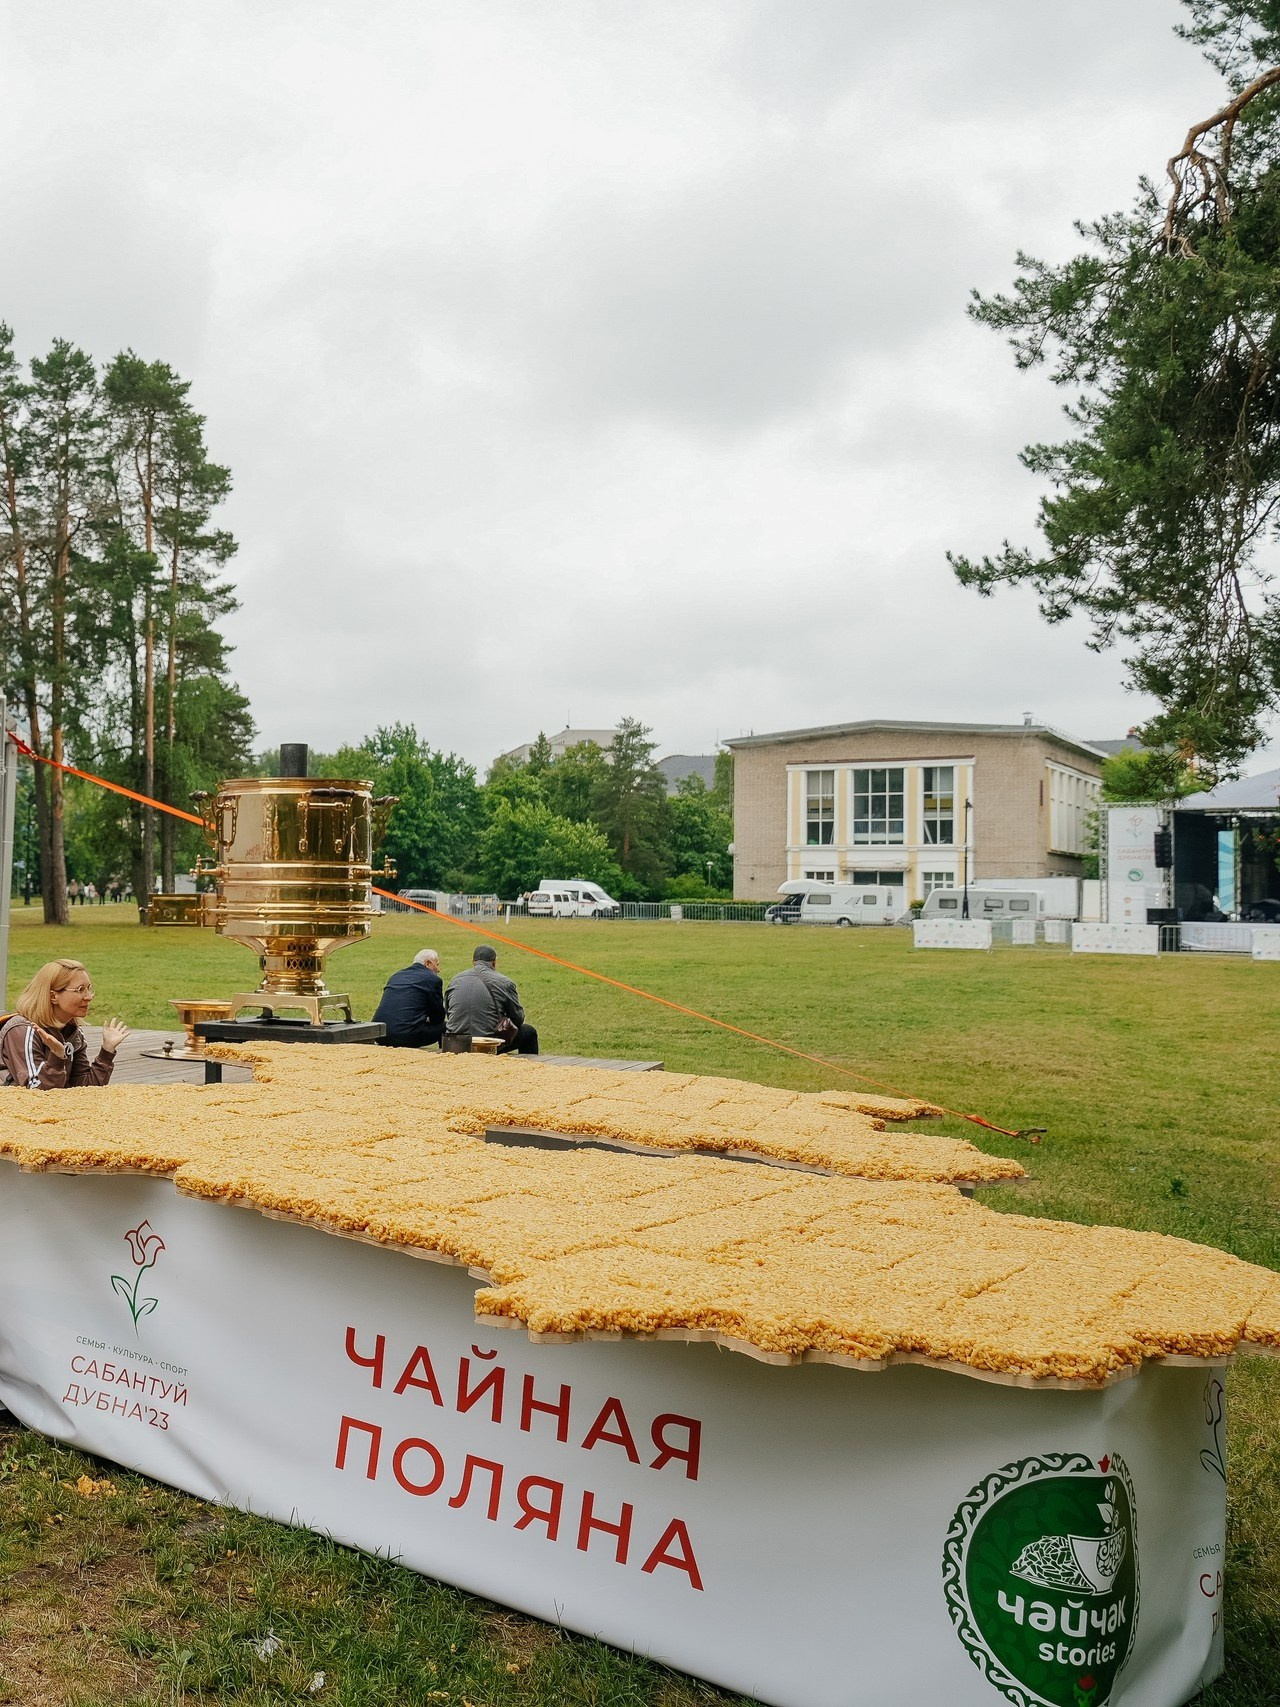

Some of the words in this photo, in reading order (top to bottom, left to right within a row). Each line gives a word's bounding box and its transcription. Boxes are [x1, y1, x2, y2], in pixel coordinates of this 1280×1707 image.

[76, 1335, 106, 1351] СЕМЬЯ
[112, 1346, 154, 1365] КУЛЬТУРА
[160, 1361, 189, 1376] СПОРТ
[71, 1355, 189, 1407] САБАНТУЙ
[344, 1326, 702, 1481] ЧАЙНАЯ
[62, 1383, 170, 1431] ДУБНА'23
[335, 1415, 705, 1592] ПОЛЯНА
[1192, 1543, 1221, 1560] СЕМЬЯ
[997, 1590, 1127, 1638] чайчак
[1038, 1641, 1117, 1666] stories
